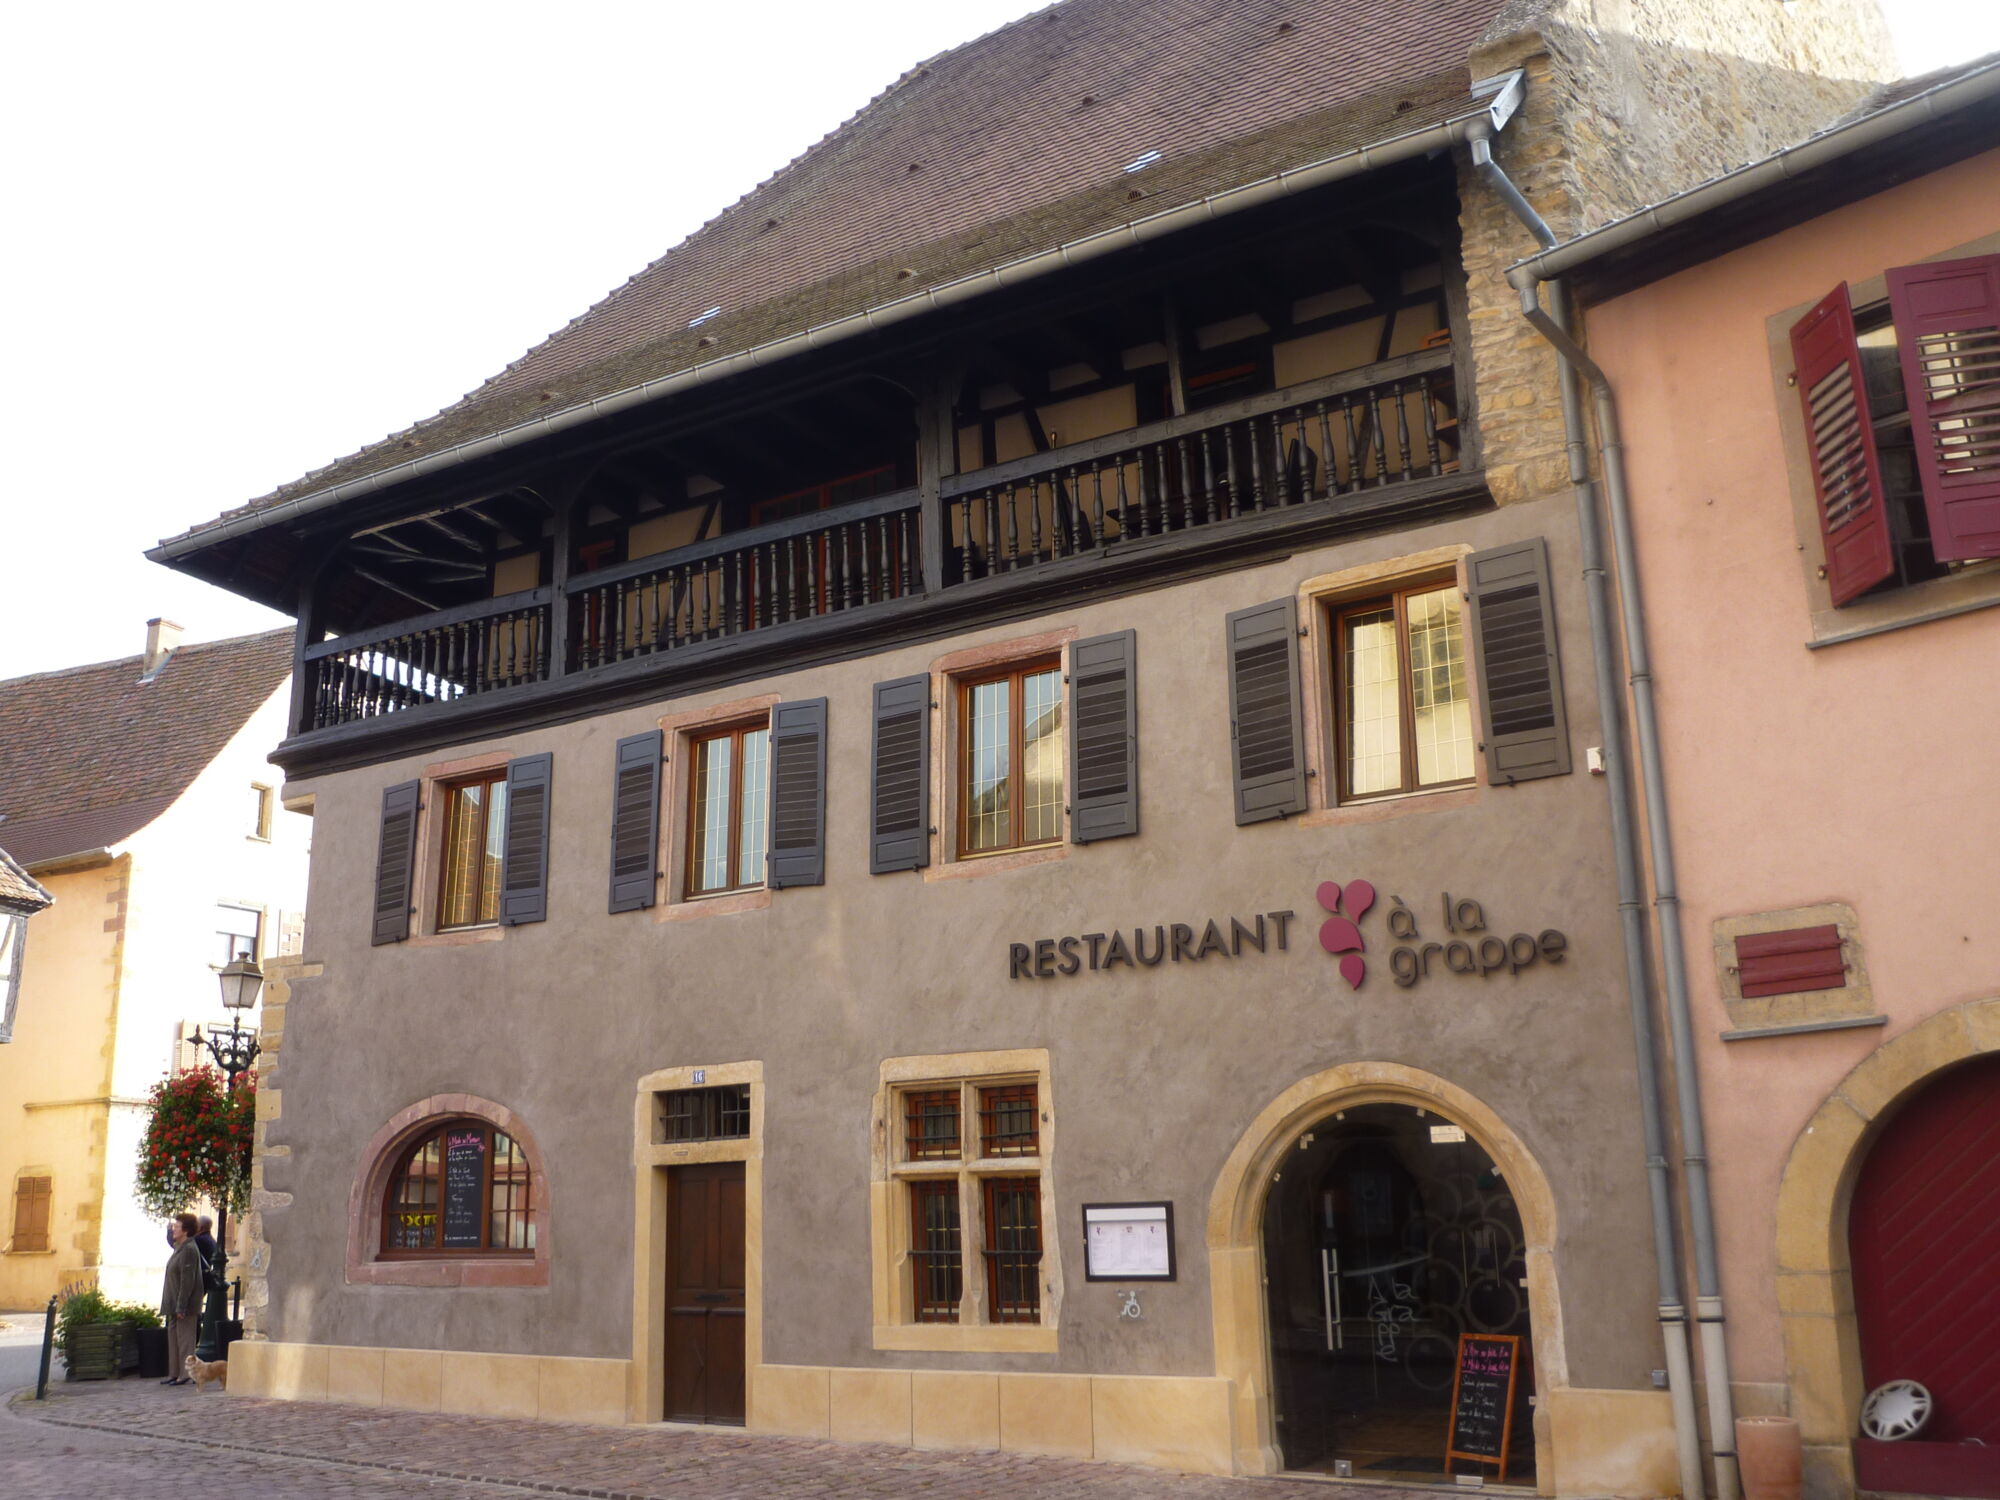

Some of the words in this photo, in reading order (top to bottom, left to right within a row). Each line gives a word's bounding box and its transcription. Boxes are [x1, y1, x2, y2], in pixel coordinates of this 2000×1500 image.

[1442, 891, 1485, 933] la
[1009, 909, 1295, 980] RESTAURANT
[1389, 929, 1568, 988] grappe
